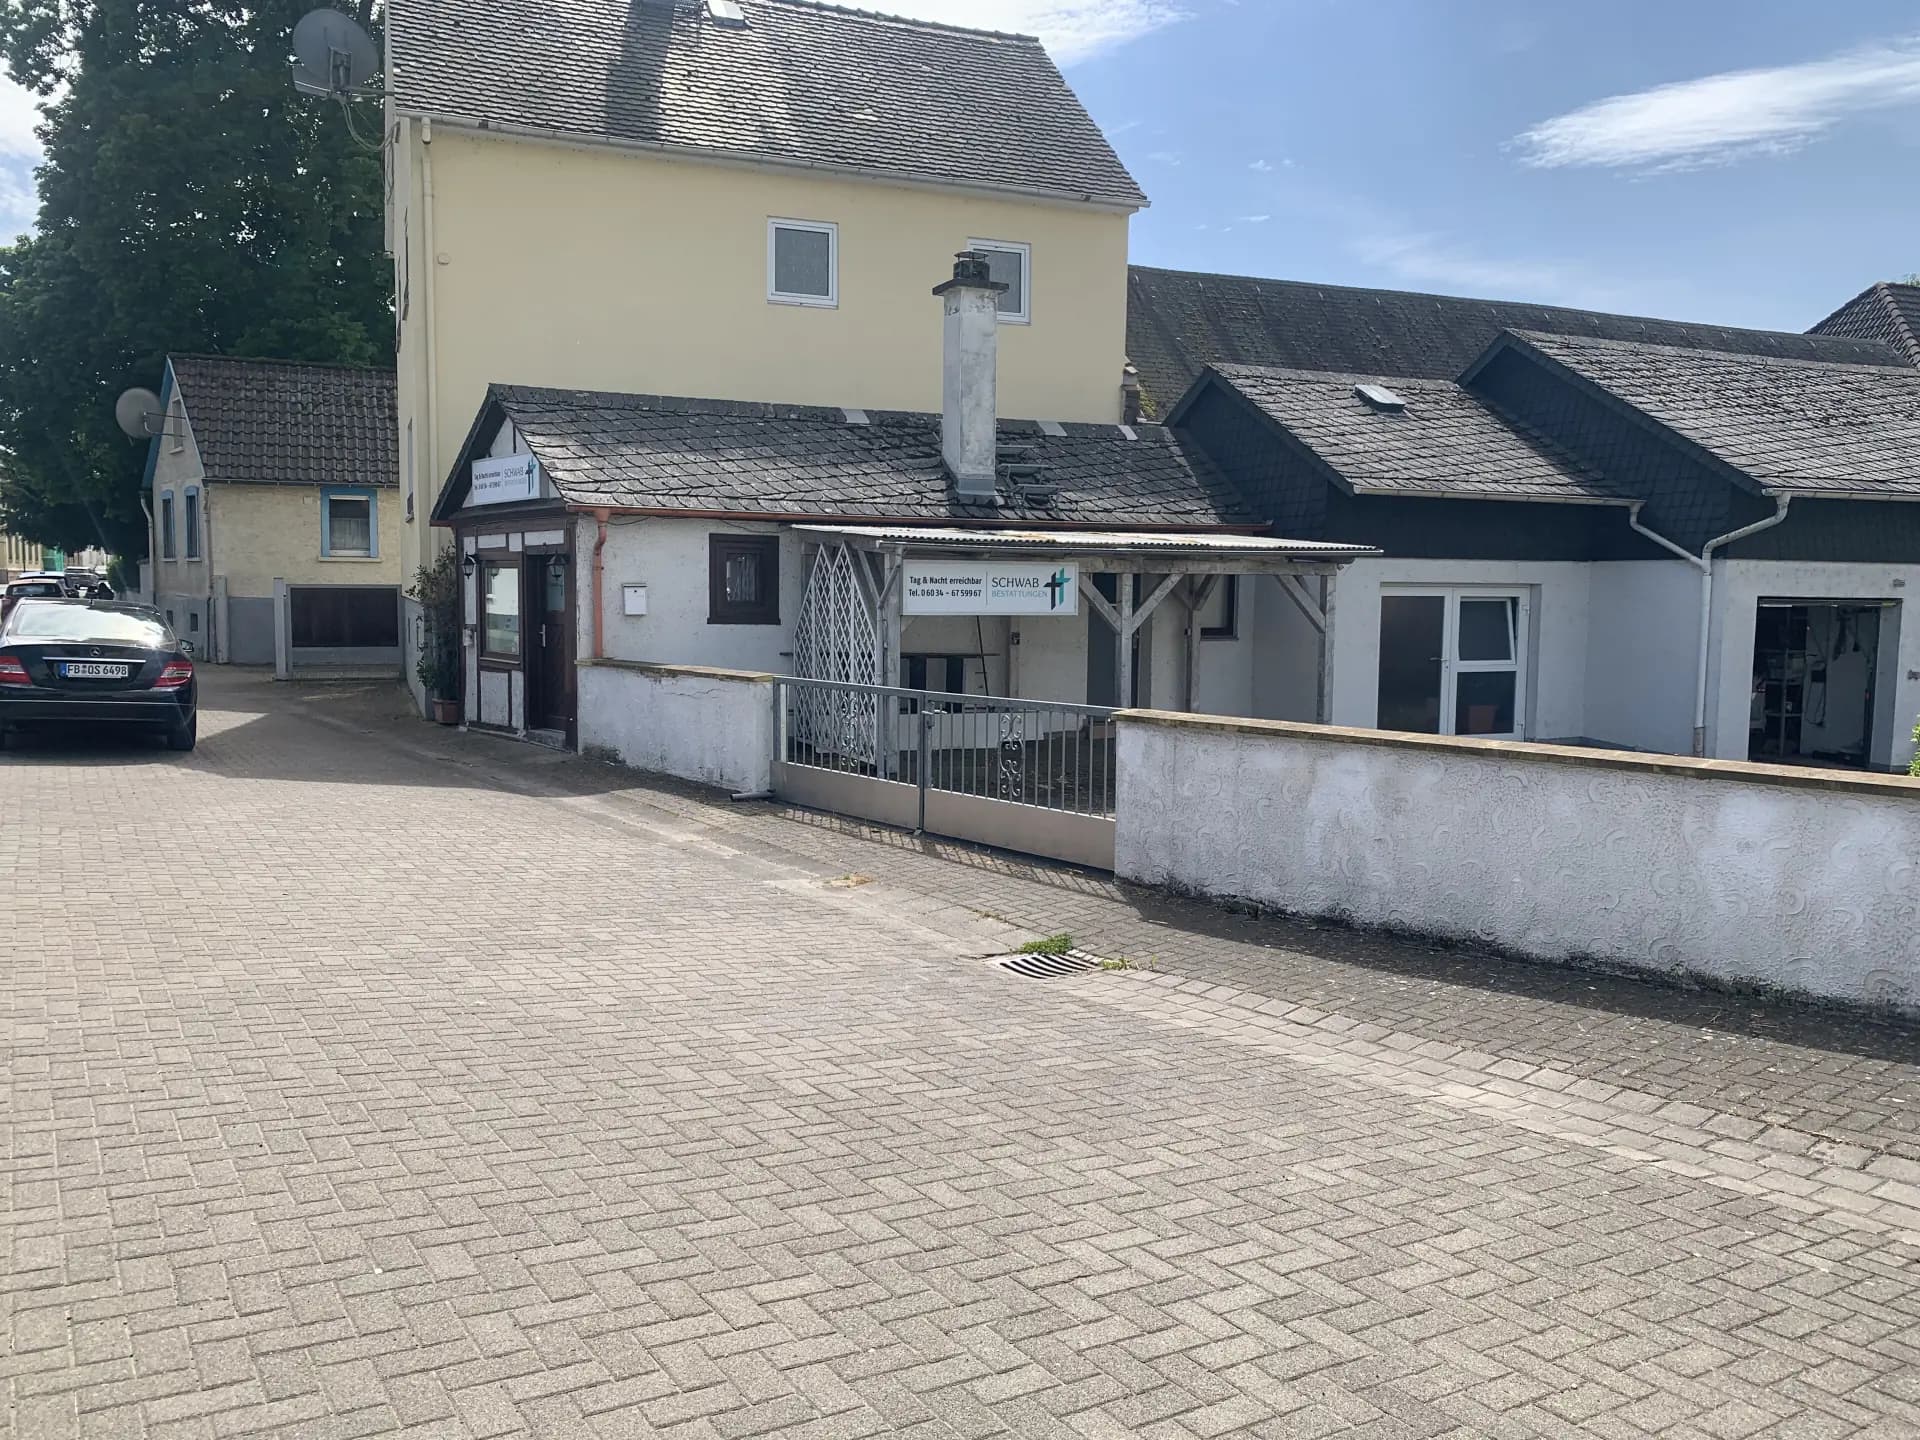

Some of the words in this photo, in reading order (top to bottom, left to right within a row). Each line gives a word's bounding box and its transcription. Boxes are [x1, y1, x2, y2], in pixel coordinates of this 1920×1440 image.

[909, 576, 921, 586] Tag
[922, 576, 928, 584] &
[929, 576, 948, 585] Nacht
[949, 576, 982, 585] erreichbar
[991, 577, 1040, 588] SCHWAB
[909, 588, 920, 597] Tel.
[991, 590, 1048, 598] BESTATTUNGEN
[67, 664, 80, 674] FB
[102, 665, 127, 676] 6498
